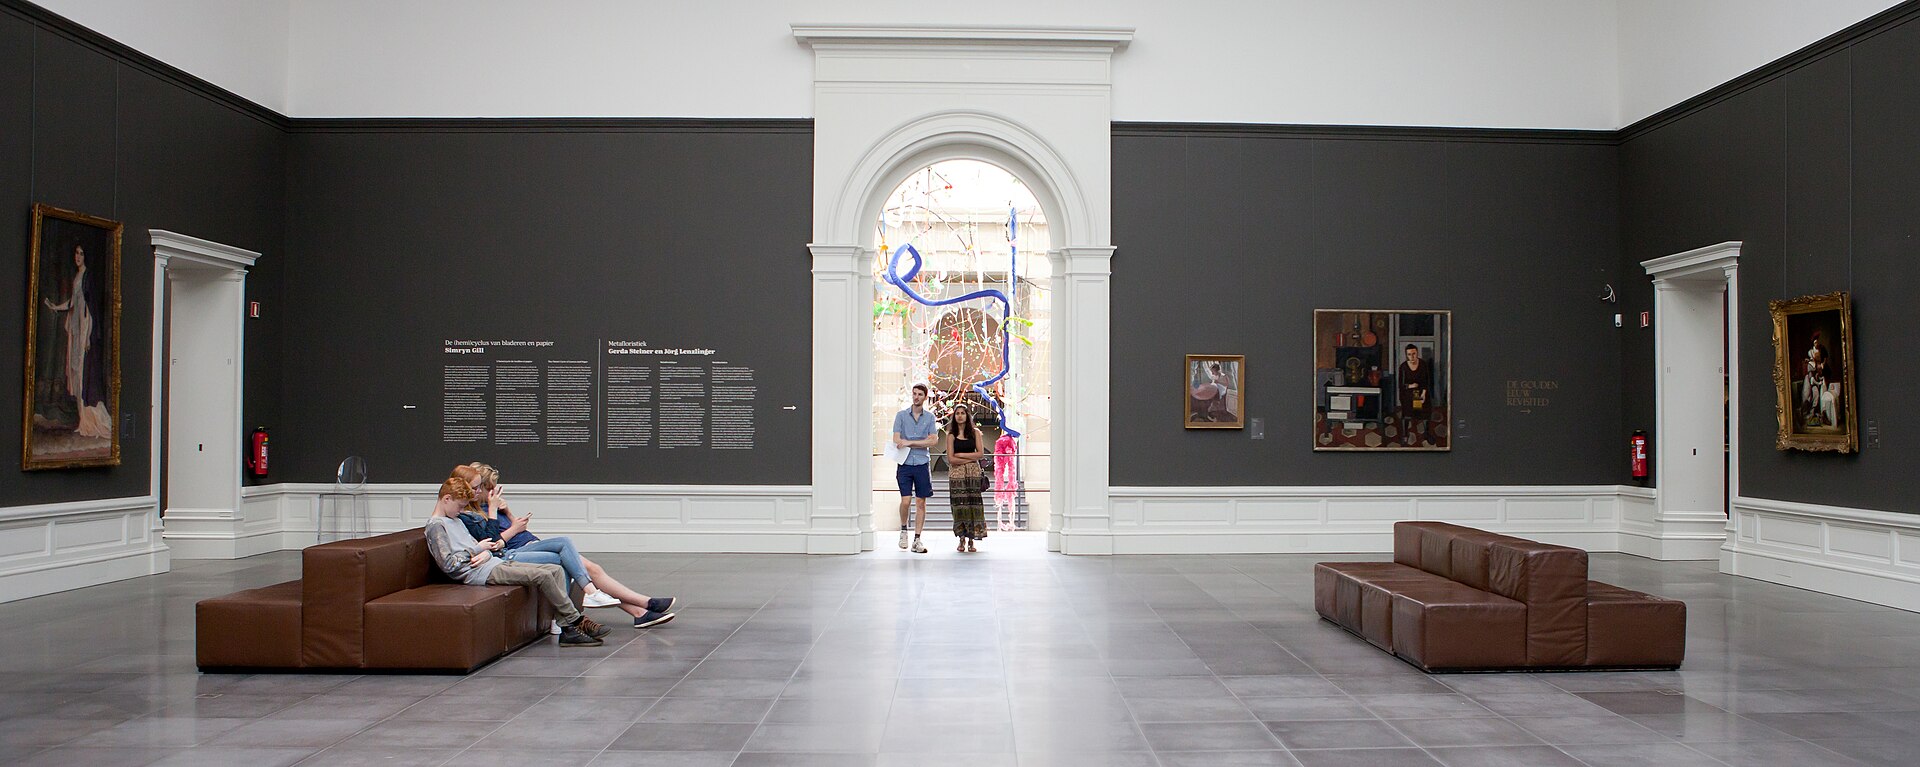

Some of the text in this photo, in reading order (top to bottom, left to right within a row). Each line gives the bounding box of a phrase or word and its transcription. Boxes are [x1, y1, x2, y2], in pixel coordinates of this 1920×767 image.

[445, 347, 471, 355] Simryn
[664, 347, 678, 356] Jörg
[679, 348, 715, 356] Lenzlinger
[1506, 380, 1518, 389] DE
